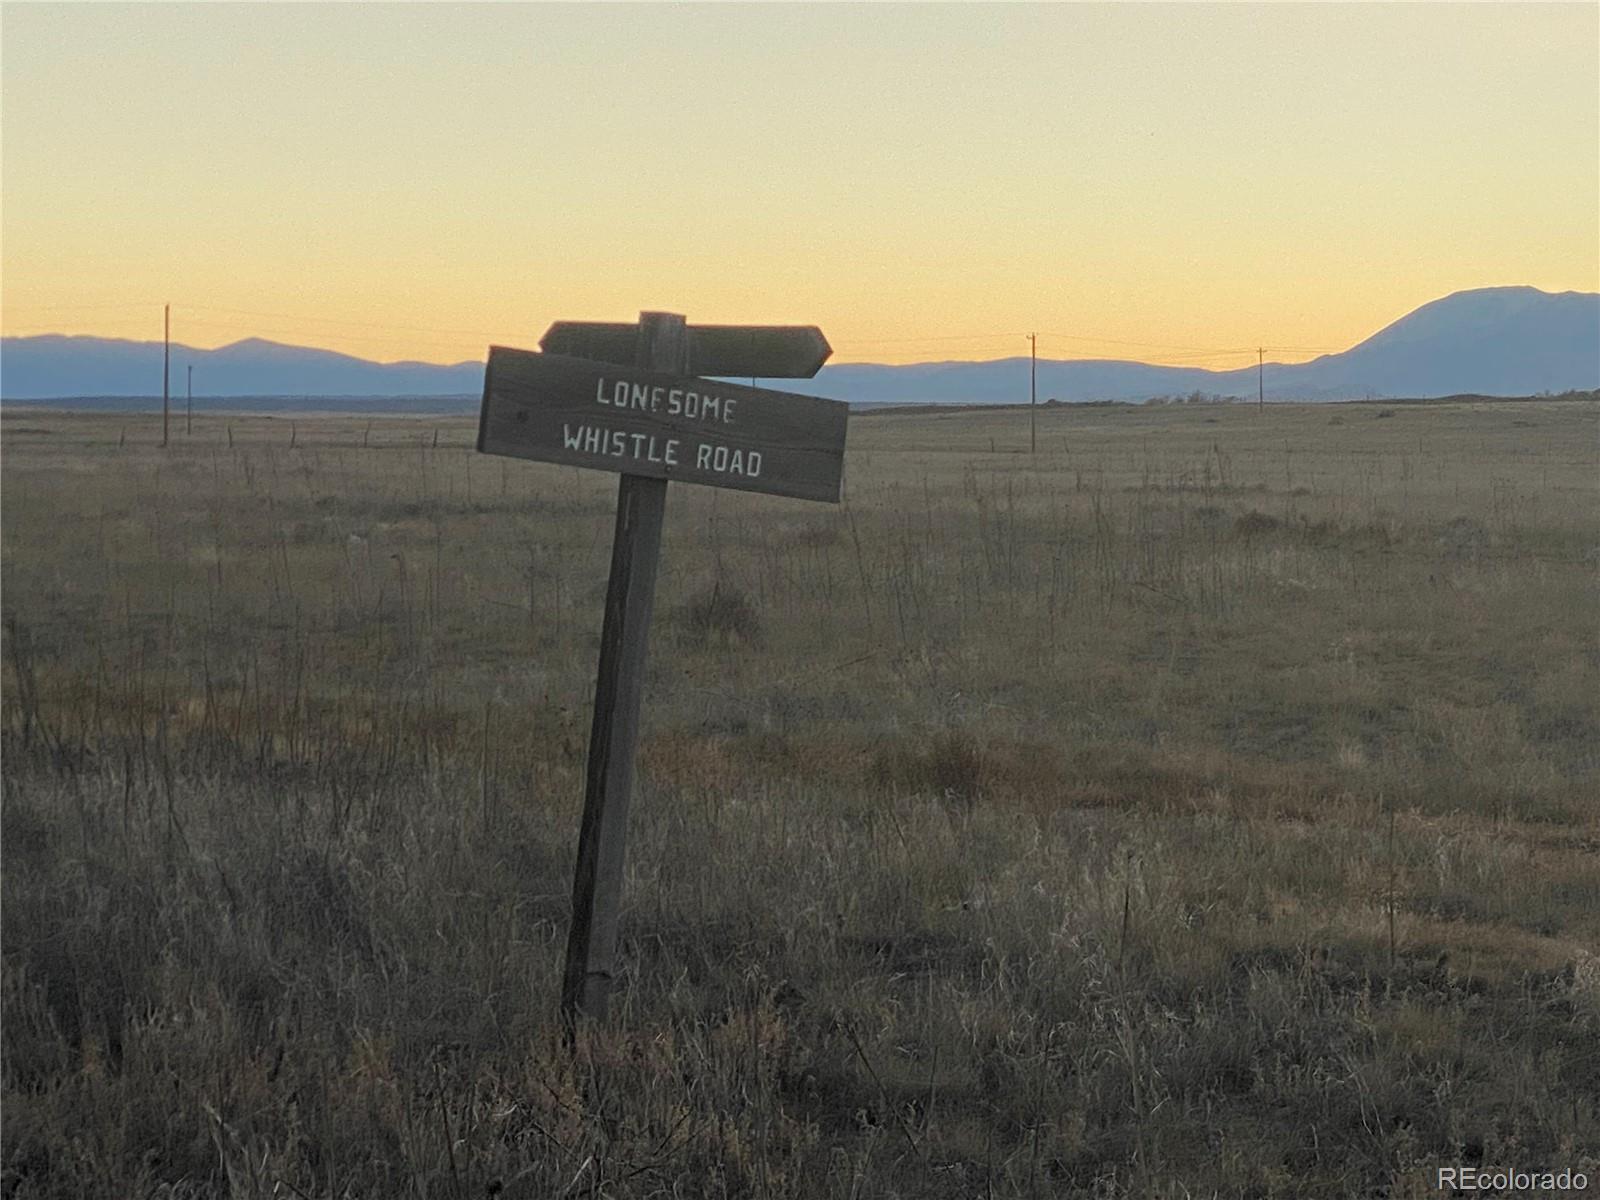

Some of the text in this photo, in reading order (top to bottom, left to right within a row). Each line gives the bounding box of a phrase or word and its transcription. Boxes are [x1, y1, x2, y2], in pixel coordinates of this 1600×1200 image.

[596, 378, 737, 424] LONESOME
[563, 424, 762, 477] WHISTLE ROAD
